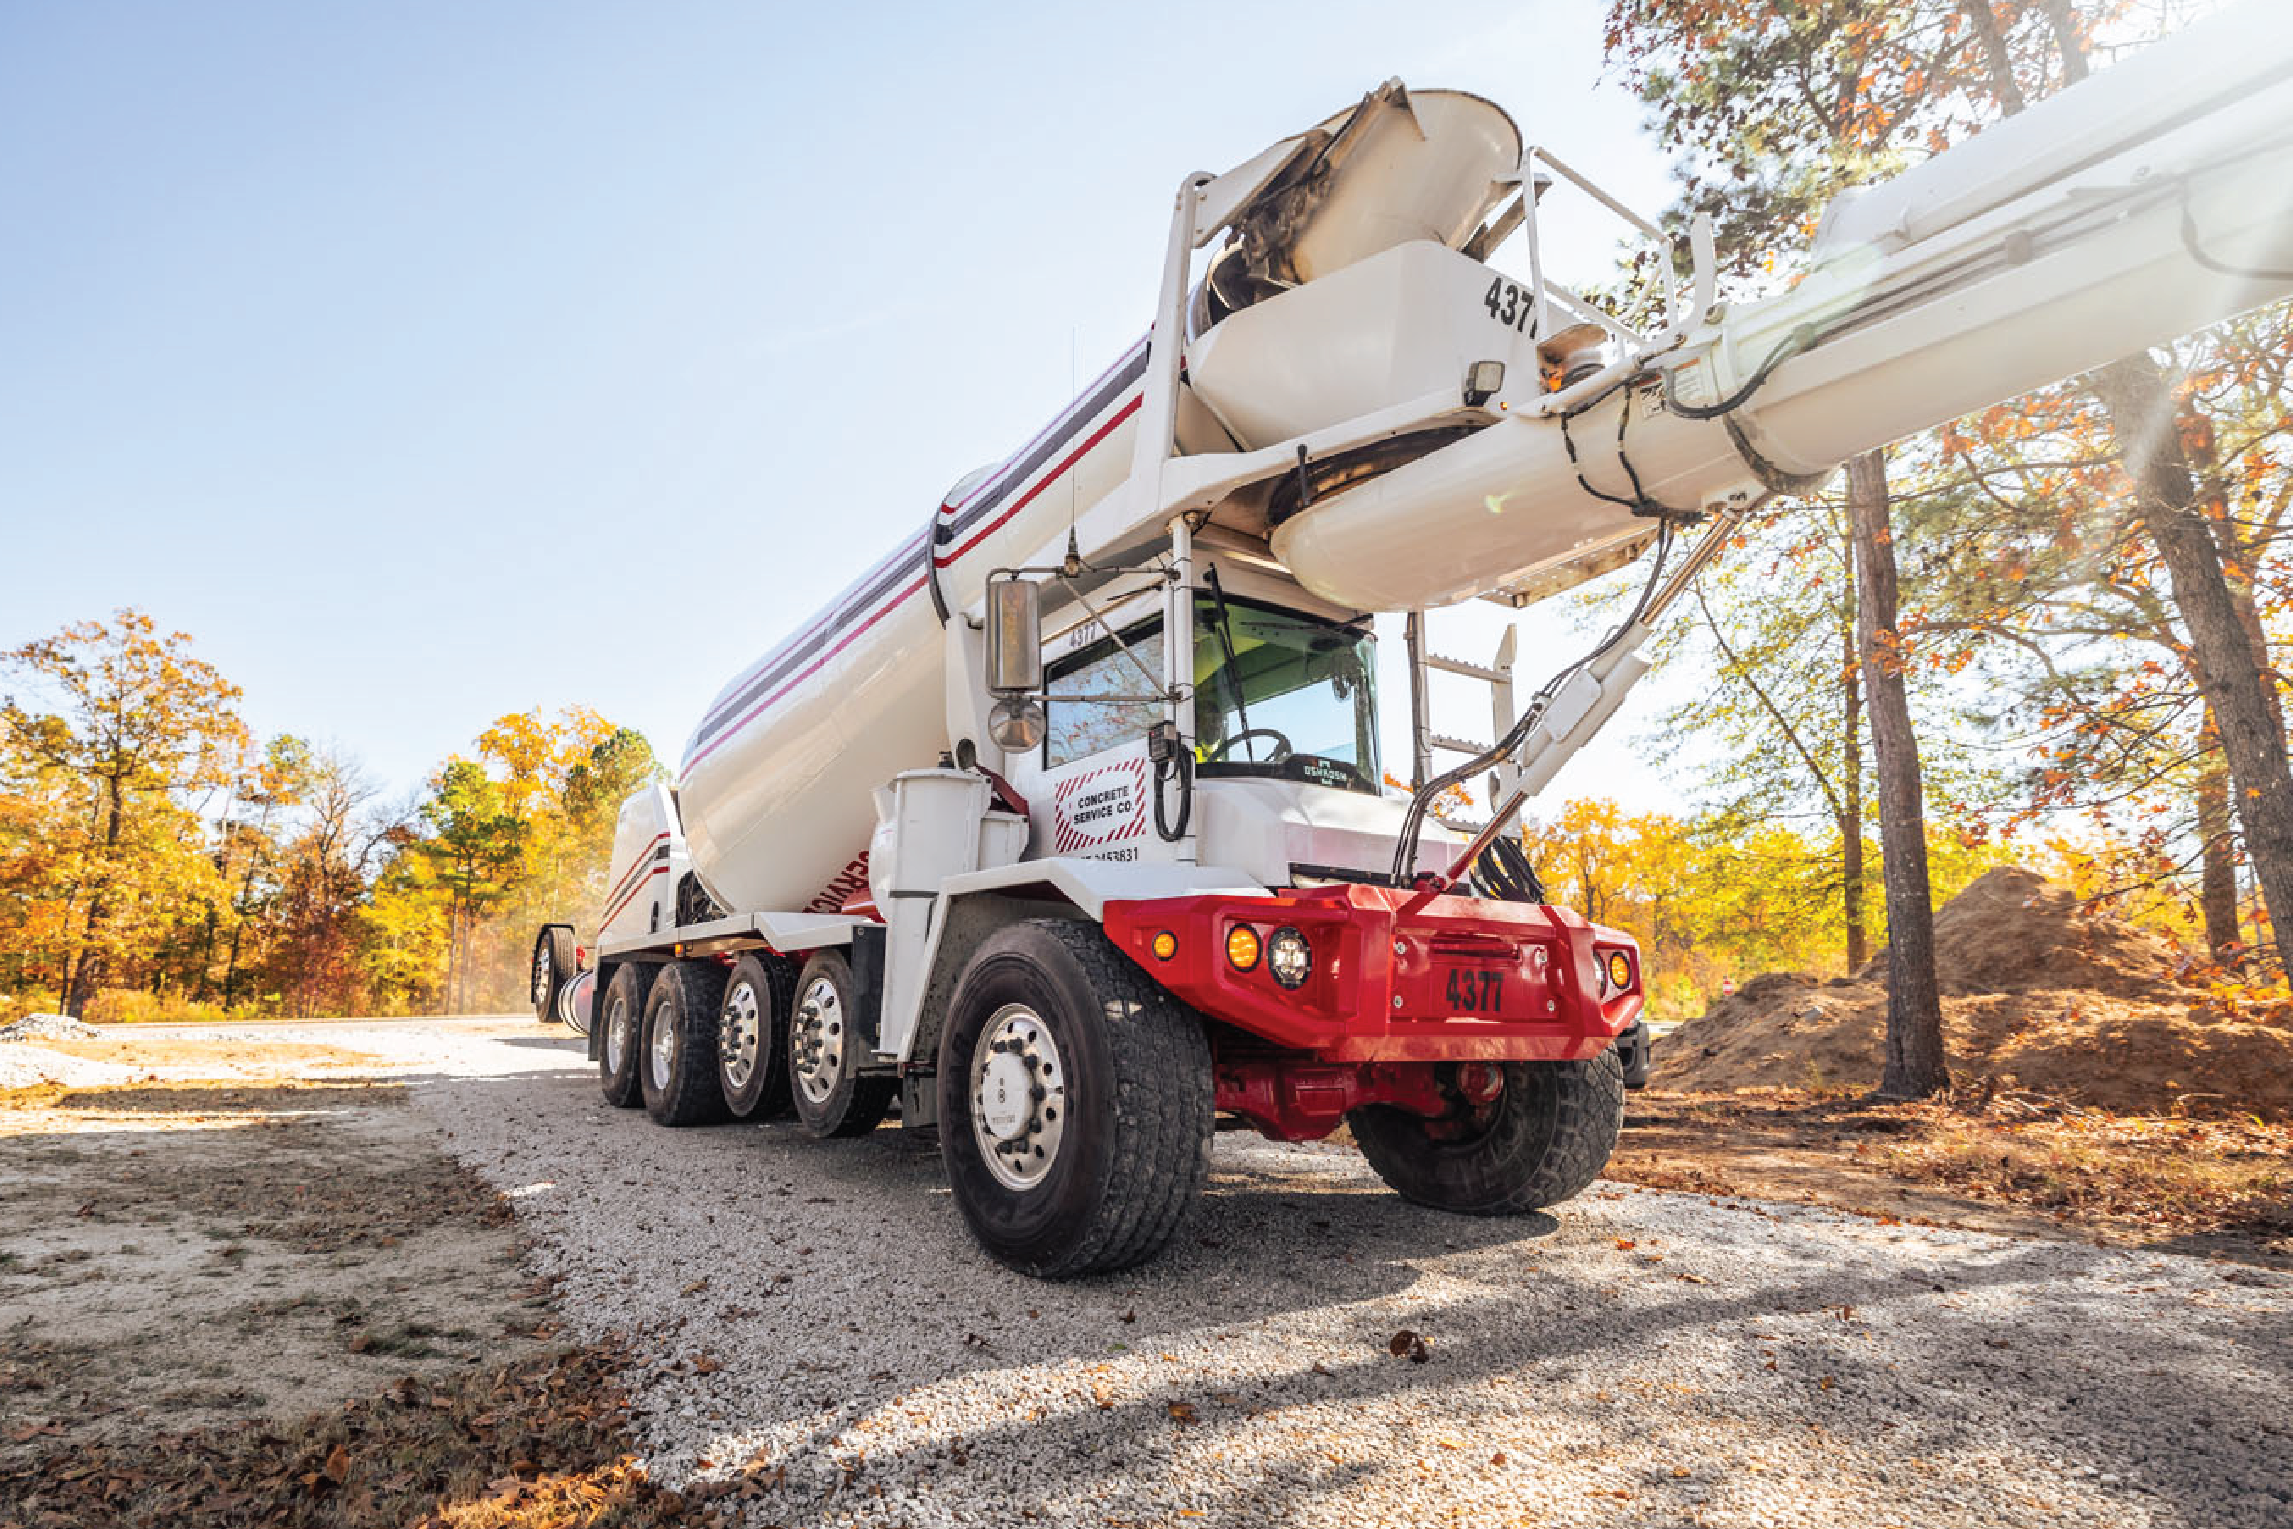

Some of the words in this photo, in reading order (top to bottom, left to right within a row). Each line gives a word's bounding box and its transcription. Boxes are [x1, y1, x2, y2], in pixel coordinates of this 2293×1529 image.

[1069, 622, 1096, 648] 4377
[1078, 786, 1129, 808] CONCRETE
[1073, 805, 1113, 825] SERVICE
[1117, 800, 1135, 813] CO.
[1446, 969, 1504, 1011] 4377
